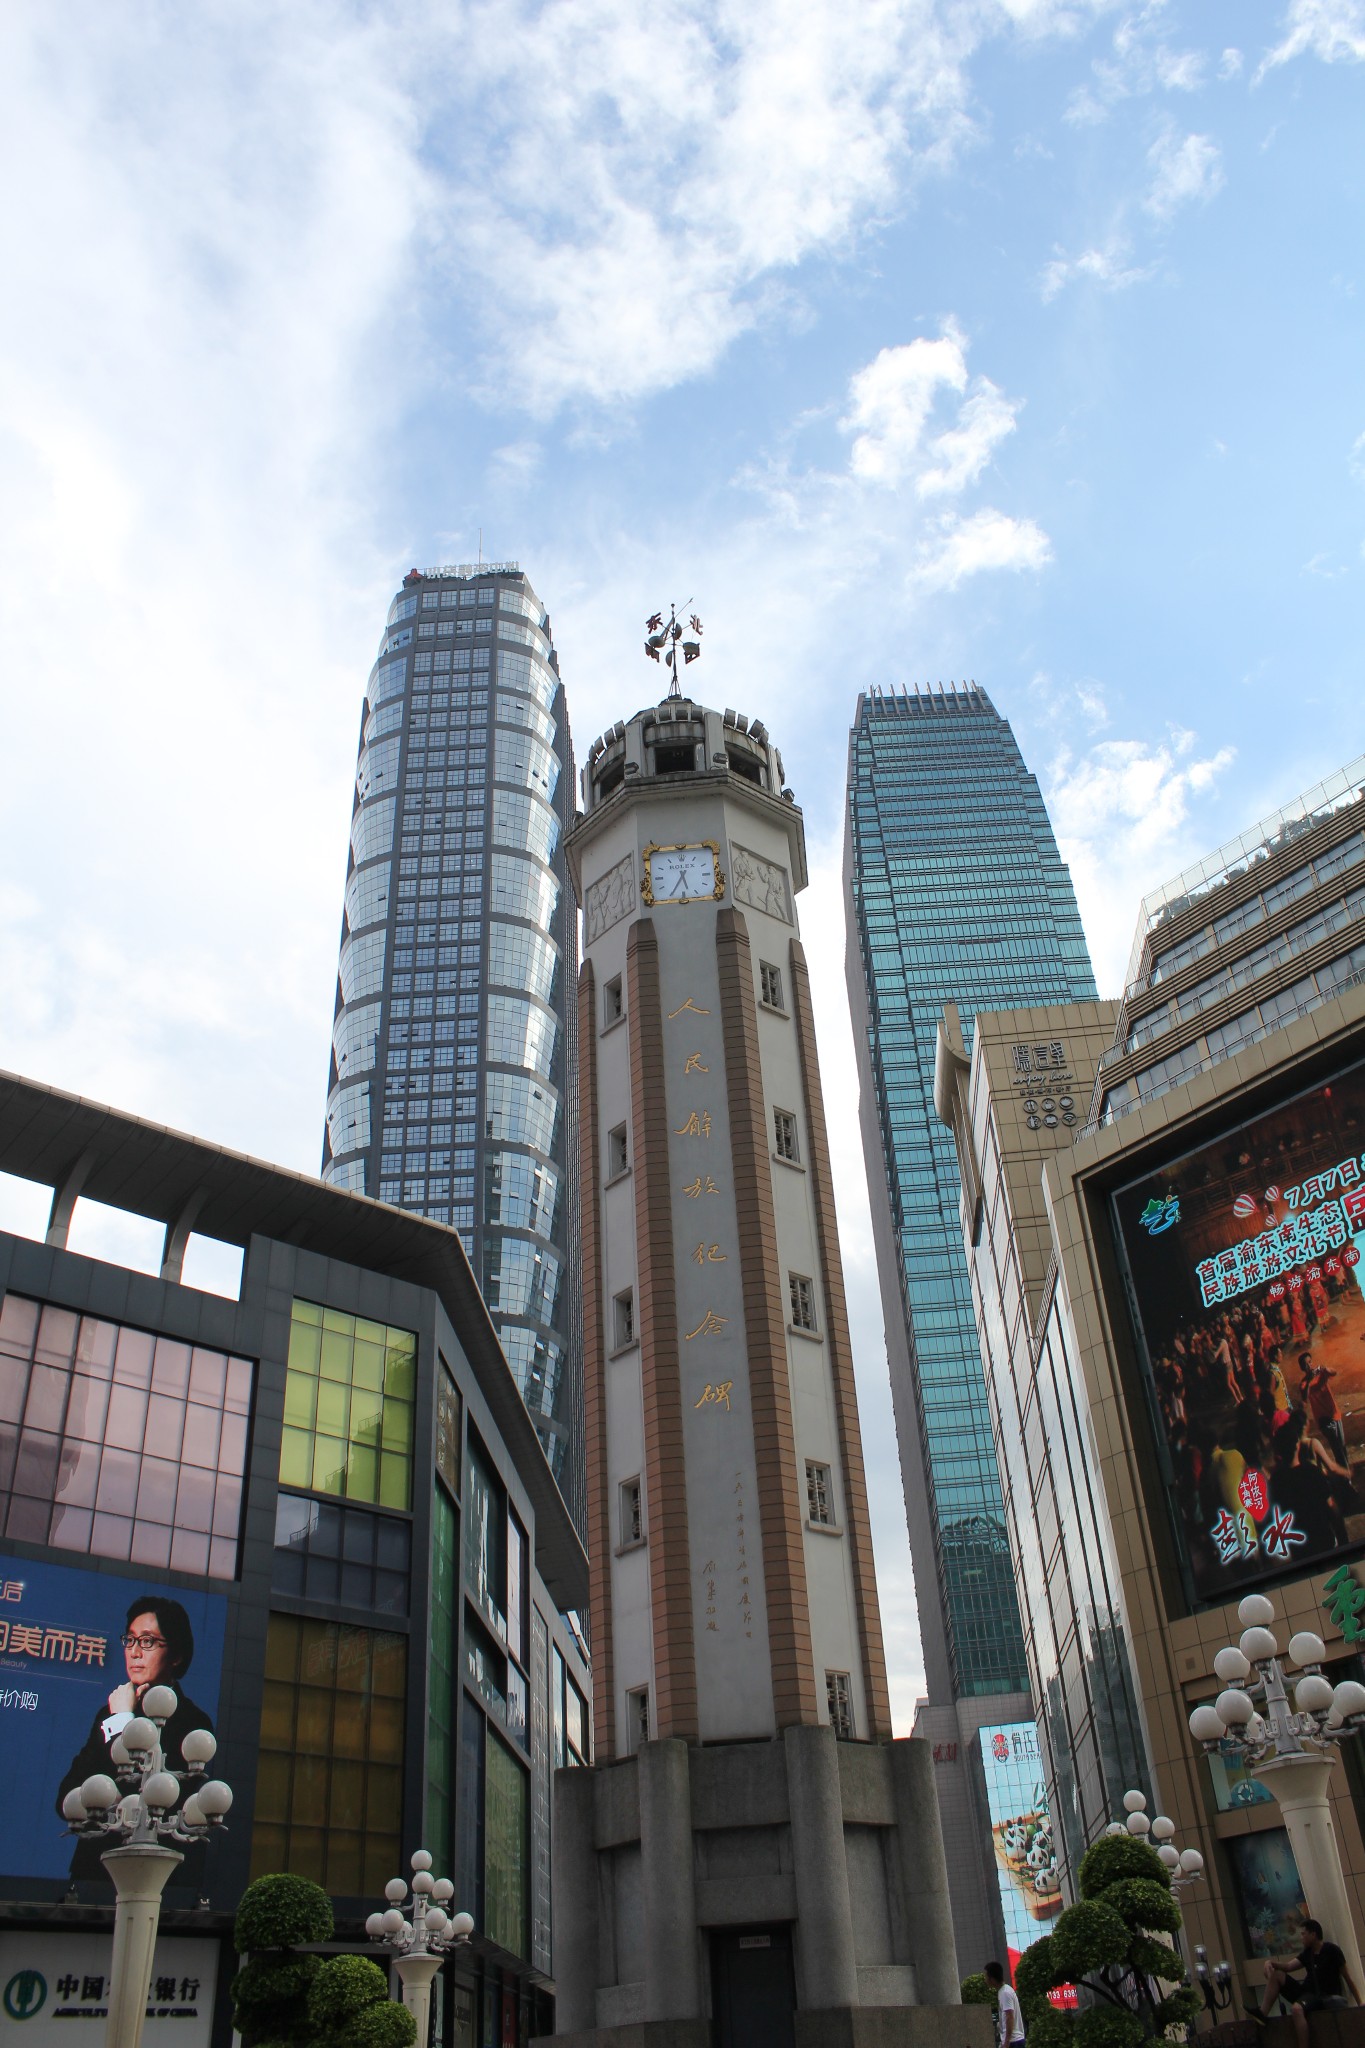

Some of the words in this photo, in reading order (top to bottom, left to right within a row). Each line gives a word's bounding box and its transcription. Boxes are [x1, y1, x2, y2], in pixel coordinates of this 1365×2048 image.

[690, 614, 704, 635] 北
[1196, 1200, 1343, 1284] 首届渝东南生态
[1201, 1221, 1347, 1307] 民族旅游文化节
[1269, 1249, 1360, 1299] 畅游渝东南
[1210, 1503, 1306, 1564] 彭水
[1012, 1729, 1041, 1754] 俏江
[56, 1974, 200, 2001] 中国银行
